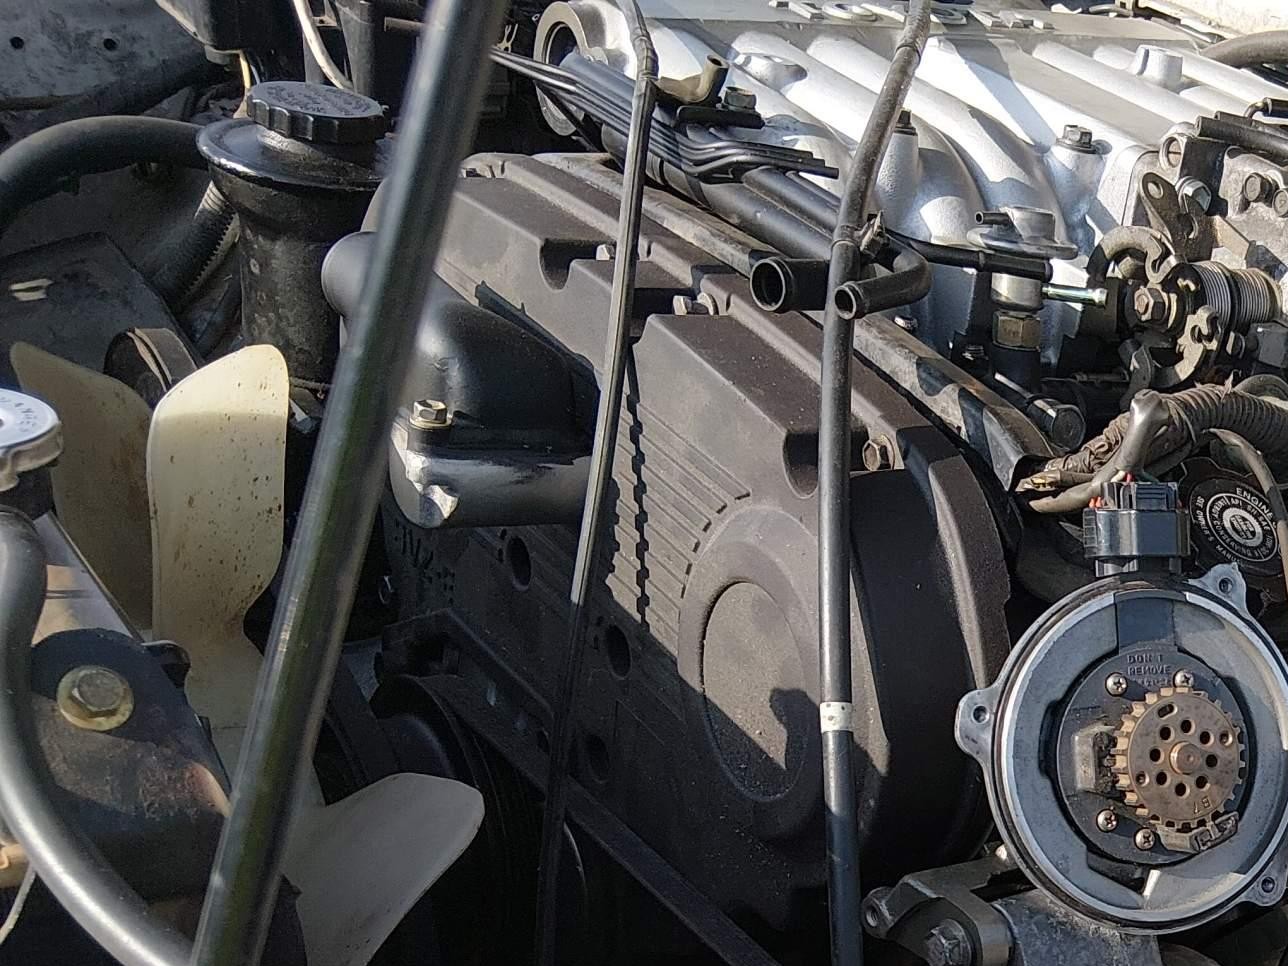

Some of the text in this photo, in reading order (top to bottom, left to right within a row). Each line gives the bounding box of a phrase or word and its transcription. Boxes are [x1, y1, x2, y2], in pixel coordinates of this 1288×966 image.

[1230, 497, 1243, 507] API
[1236, 487, 1273, 520] ENGINE
[1127, 664, 1171, 676] REMOVE
